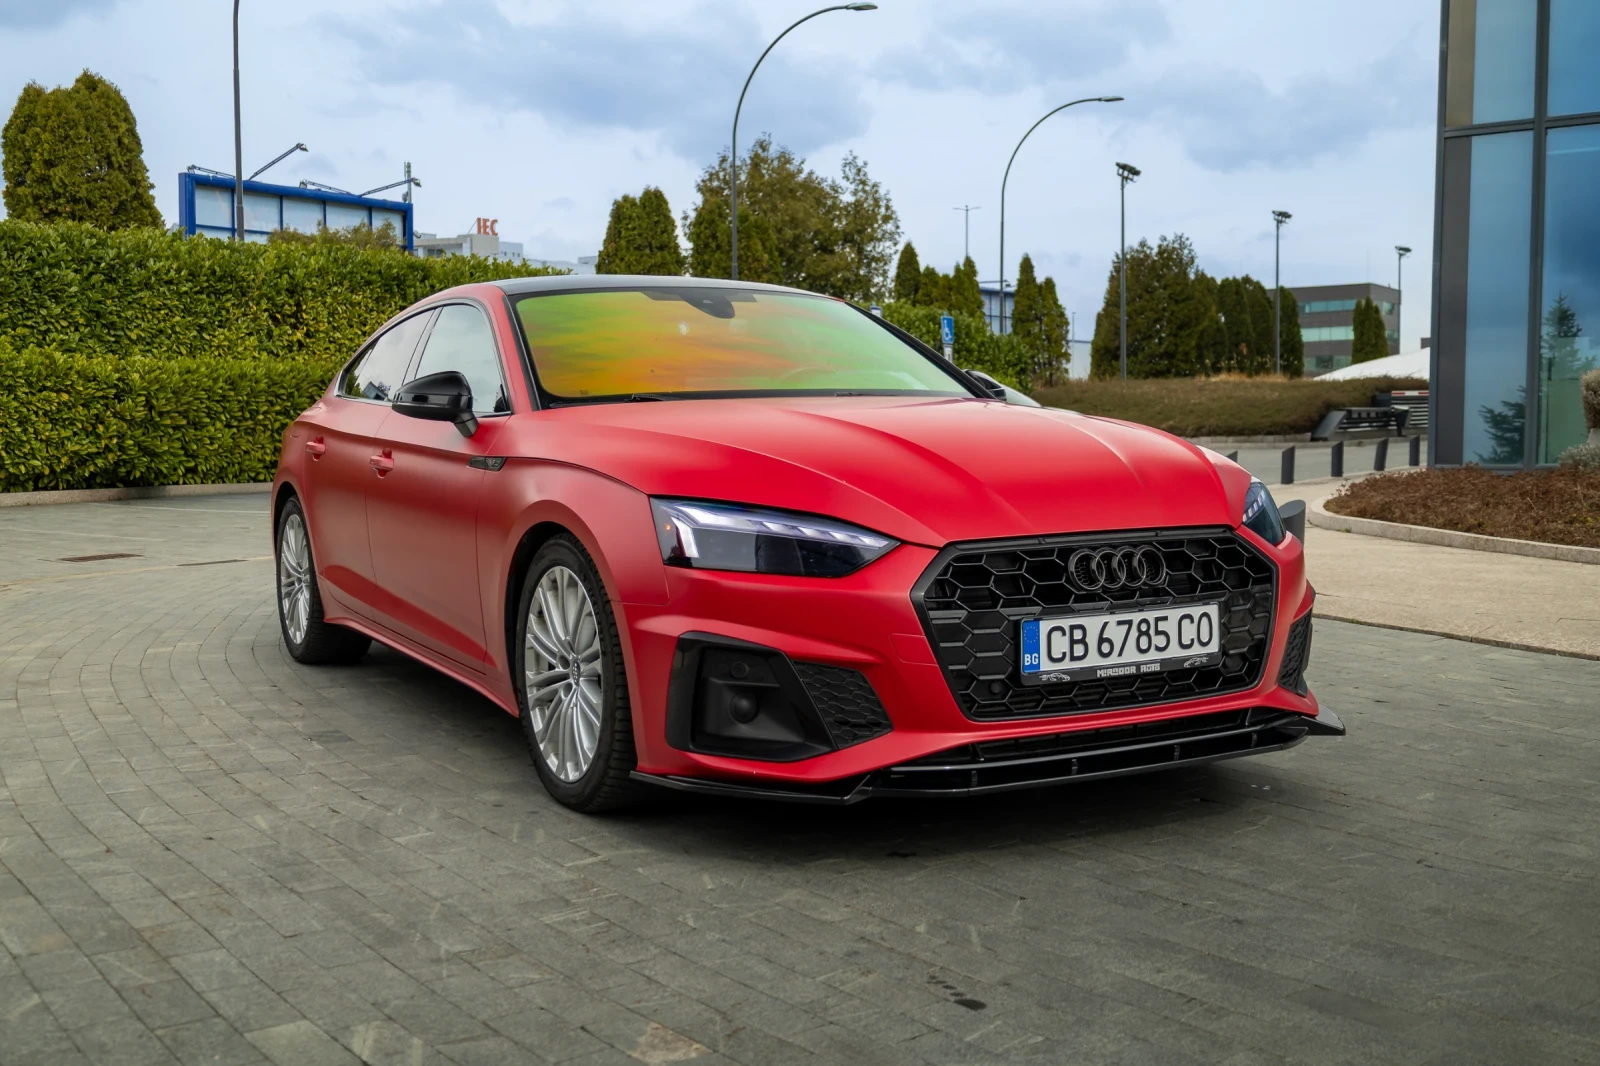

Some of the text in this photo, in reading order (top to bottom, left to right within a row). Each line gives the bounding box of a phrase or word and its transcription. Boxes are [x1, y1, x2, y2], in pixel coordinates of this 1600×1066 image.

[477, 217, 498, 236] IEC
[1047, 612, 1213, 663] CB 6785 CO
[1024, 653, 1039, 666] BG
